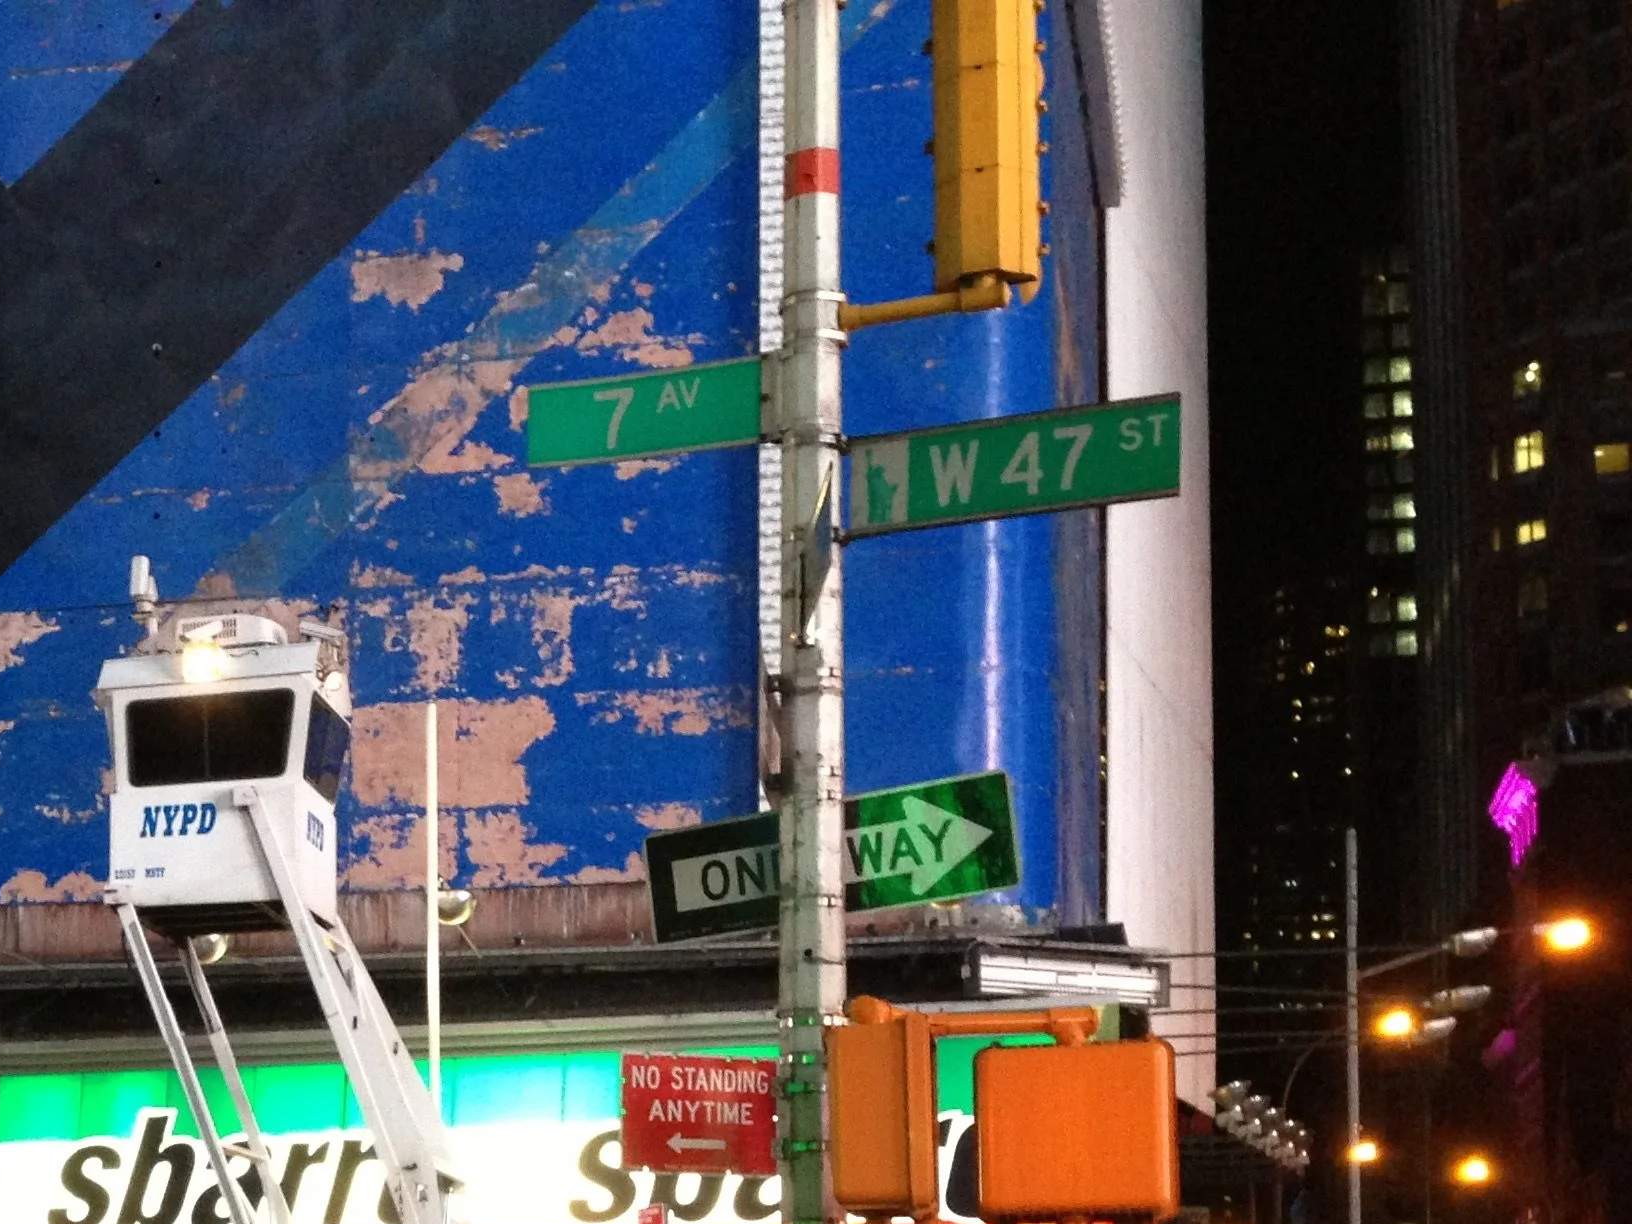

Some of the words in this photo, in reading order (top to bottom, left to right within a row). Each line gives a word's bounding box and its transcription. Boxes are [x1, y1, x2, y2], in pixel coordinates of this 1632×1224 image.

[594, 389, 634, 450] 7
[655, 377, 702, 413] AV
[930, 446, 979, 508] W
[1000, 424, 1094, 496] 47
[1120, 414, 1169, 452] ST
[139, 802, 216, 837] NYPD
[846, 820, 955, 876] WAY
[632, 1065, 660, 1089] NO
[671, 1066, 768, 1094] STANDING
[649, 1099, 754, 1126] ANYTIME
